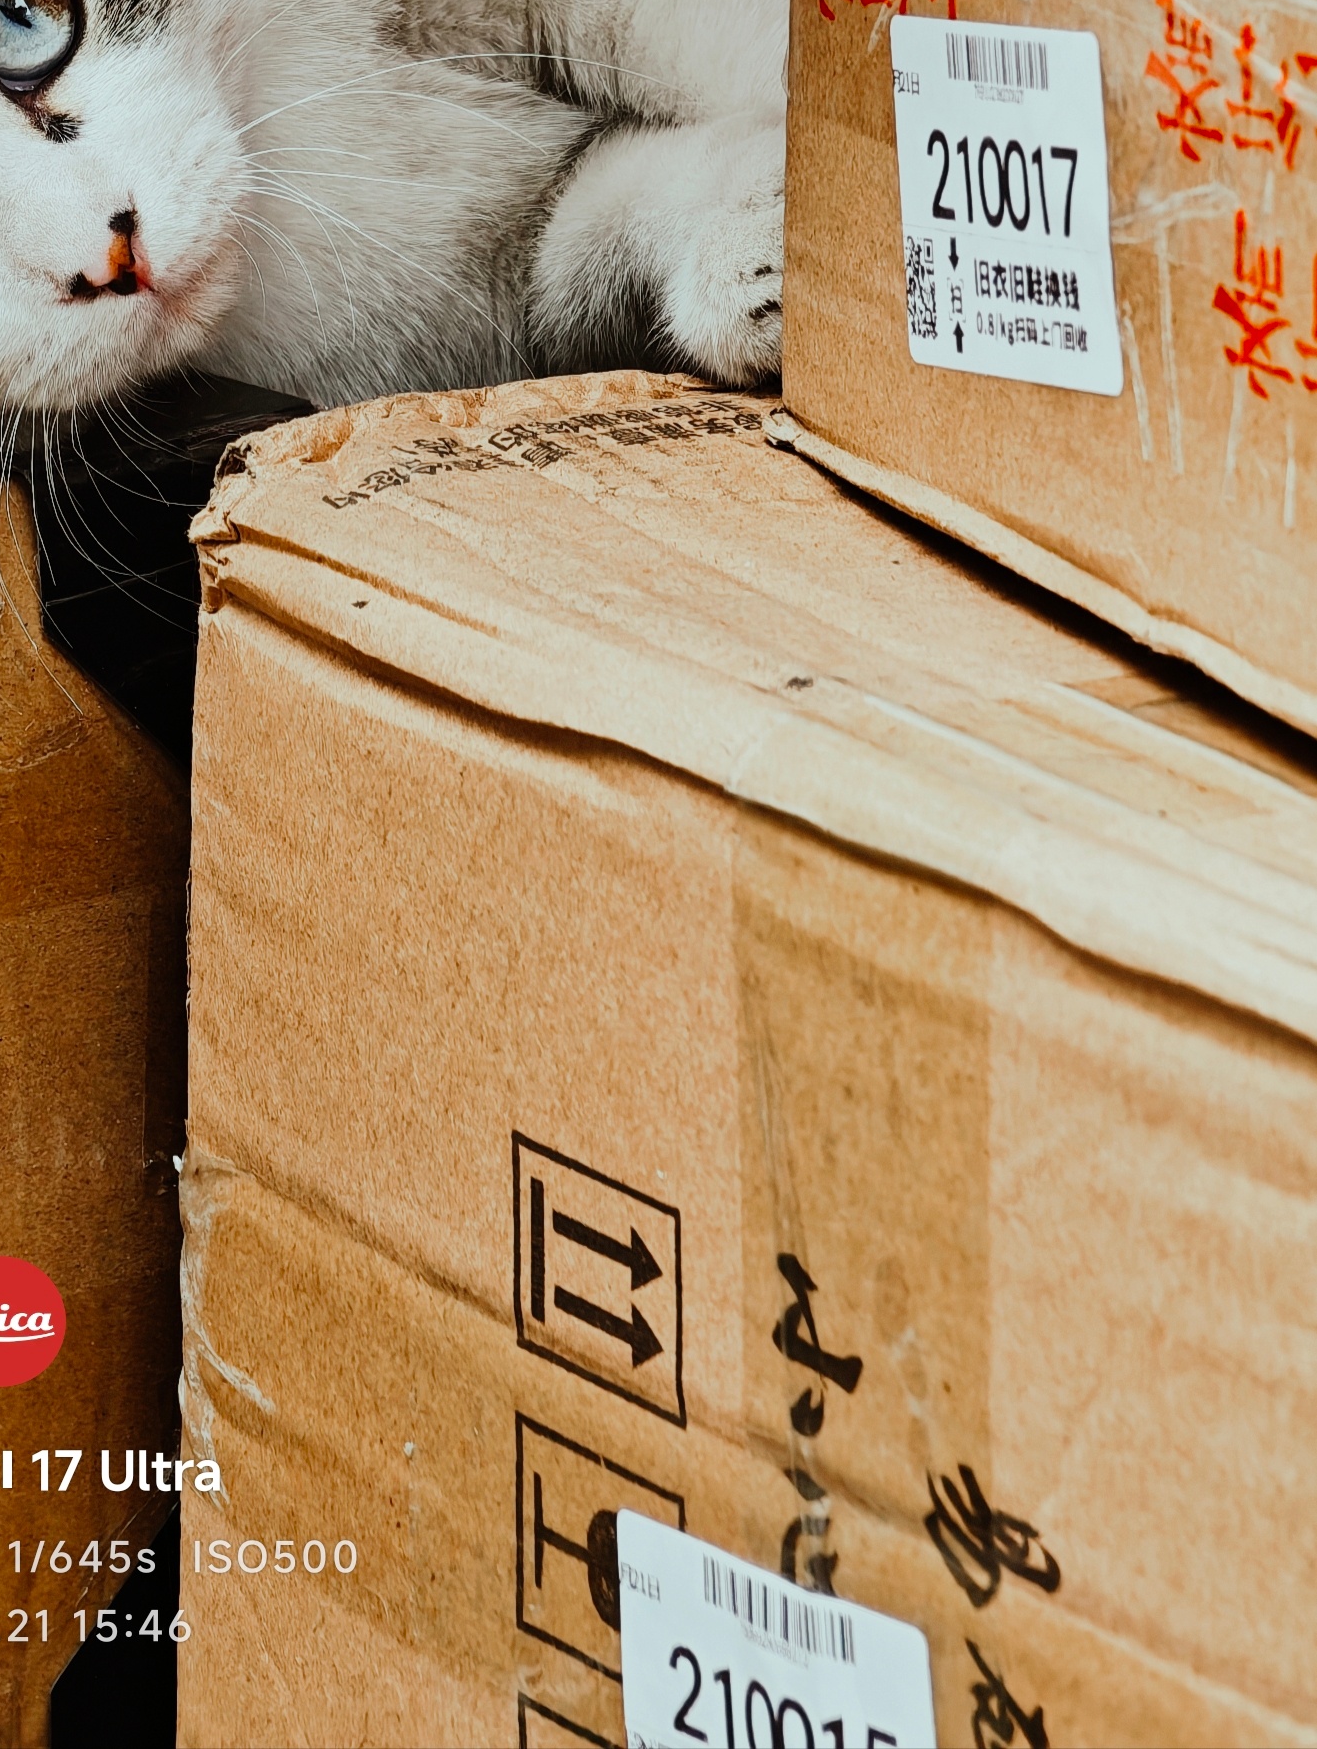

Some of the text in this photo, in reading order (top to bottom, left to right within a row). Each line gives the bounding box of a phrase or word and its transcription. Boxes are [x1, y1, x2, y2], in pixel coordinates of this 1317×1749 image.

[927, 129, 1078, 238] 210017
[973, 257, 1080, 312] 旧衣旧鞋换钱
[669, 1646, 897, 1749] 2100
